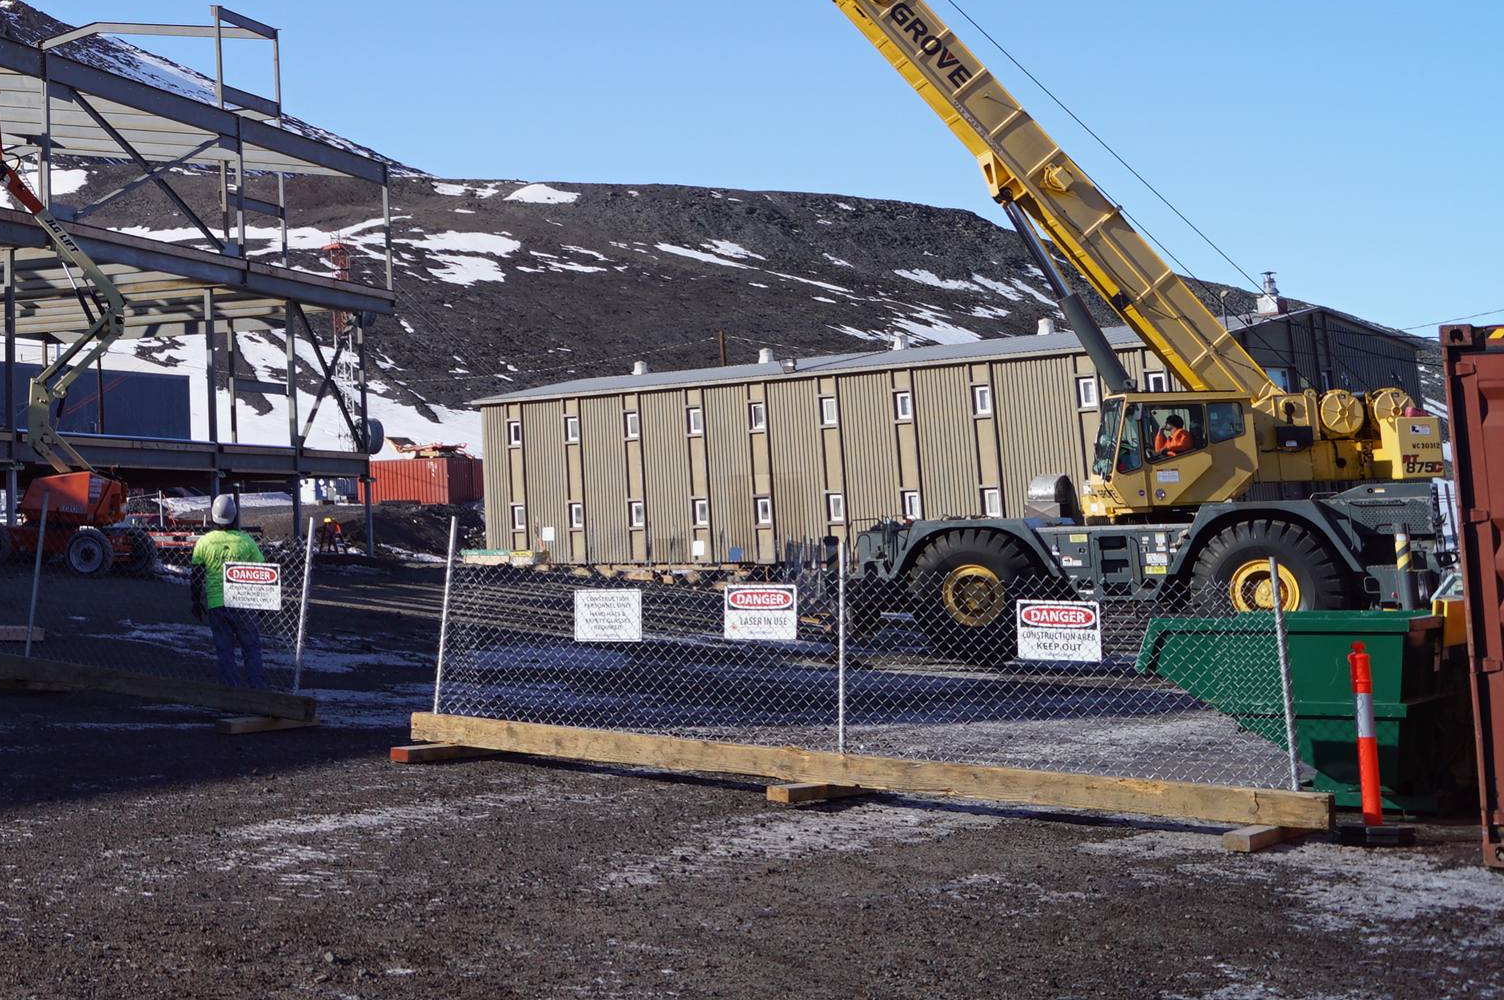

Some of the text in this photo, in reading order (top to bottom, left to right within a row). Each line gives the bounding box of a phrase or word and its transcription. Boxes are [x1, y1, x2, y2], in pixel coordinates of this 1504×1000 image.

[890, 2, 972, 88] GROVE
[44, 220, 79, 252] JLG LIFT
[1406, 461, 1442, 473] 875C
[233, 570, 270, 580] DANGER
[736, 594, 784, 605] DANGER
[740, 617, 787, 625] LASER IN USE
[1030, 610, 1085, 623] DANGER
[1023, 631, 1076, 640] CONSTRUCTION
